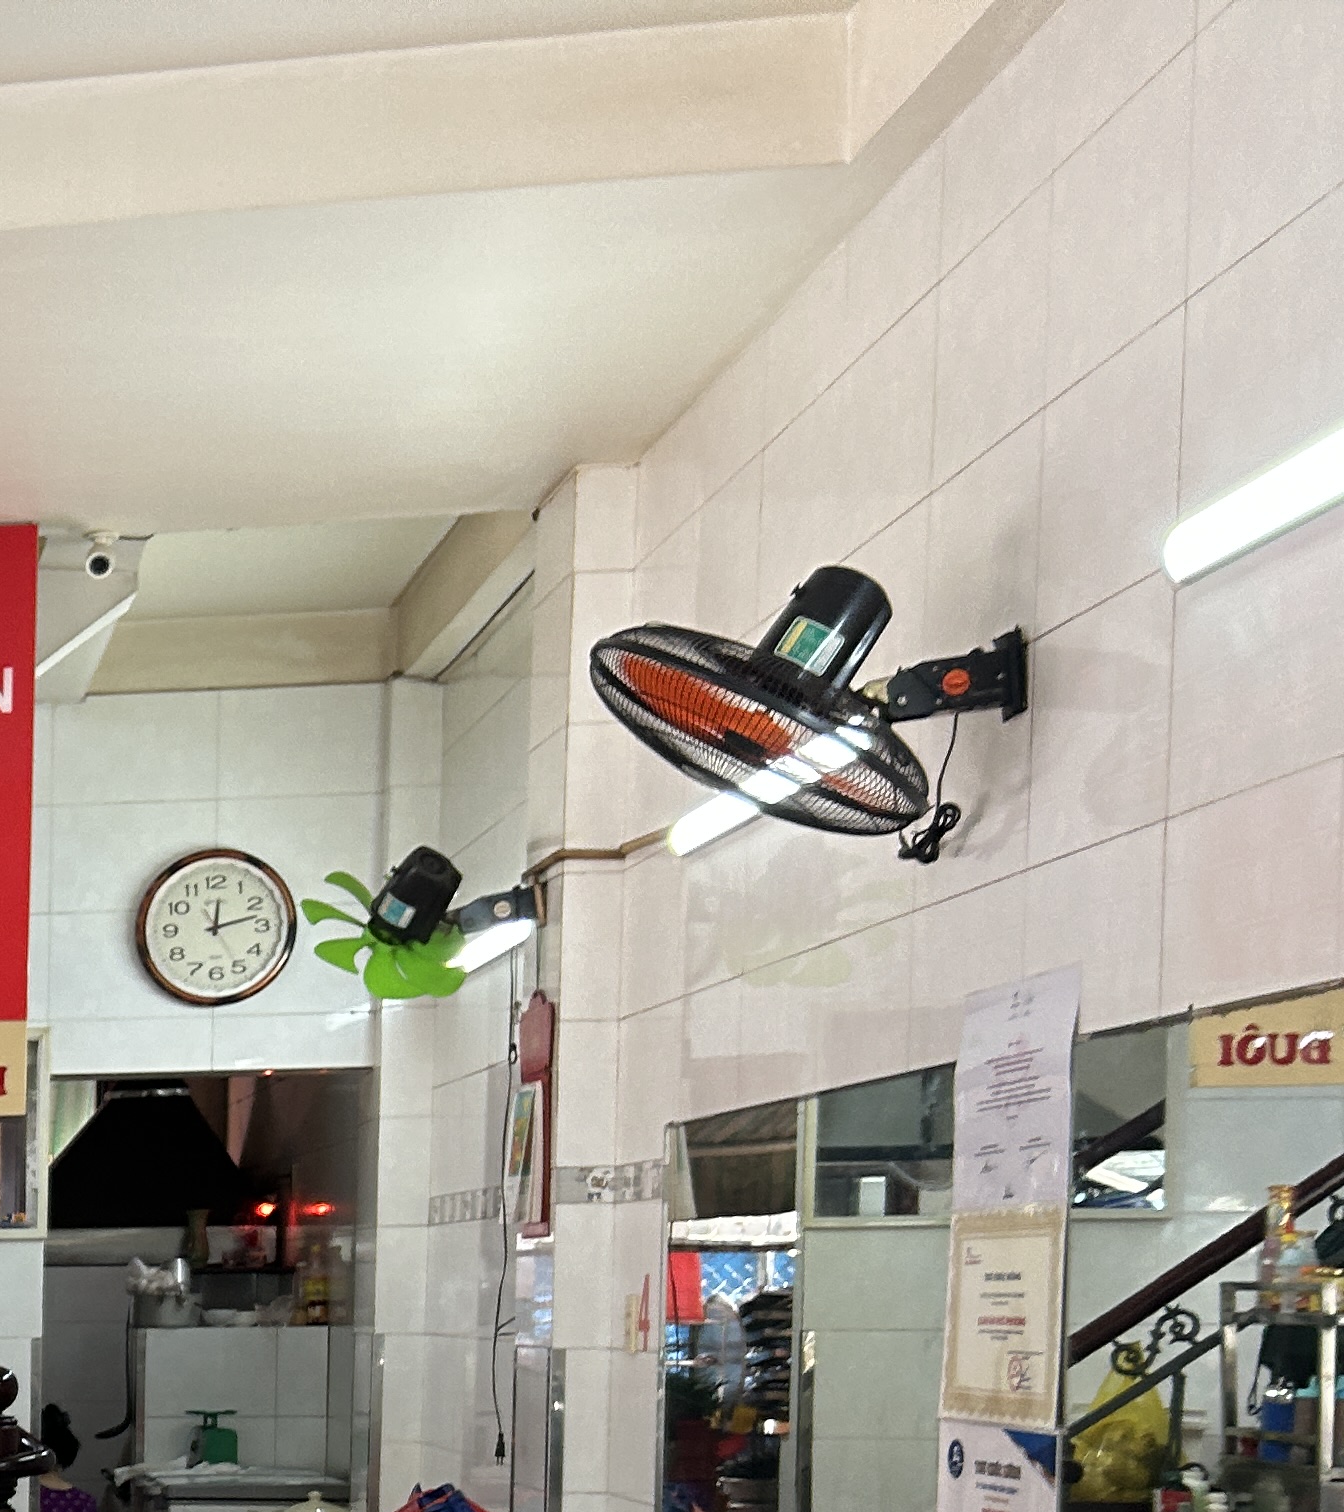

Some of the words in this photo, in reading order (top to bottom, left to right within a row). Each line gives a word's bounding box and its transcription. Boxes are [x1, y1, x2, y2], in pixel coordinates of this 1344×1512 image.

[205, 875, 227, 889] 12
[184, 883, 199, 897] 11
[167, 900, 190, 916] 10
[247, 896, 264, 911] 2
[162, 923, 179, 938] 9
[254, 919, 270, 933] 3
[168, 946, 185, 961] 8
[246, 942, 263, 957] 4
[187, 961, 203, 976] 7
[208, 966, 225, 981] 6
[230, 959, 247, 975] 5
[638, 1273, 650, 1352] 4
